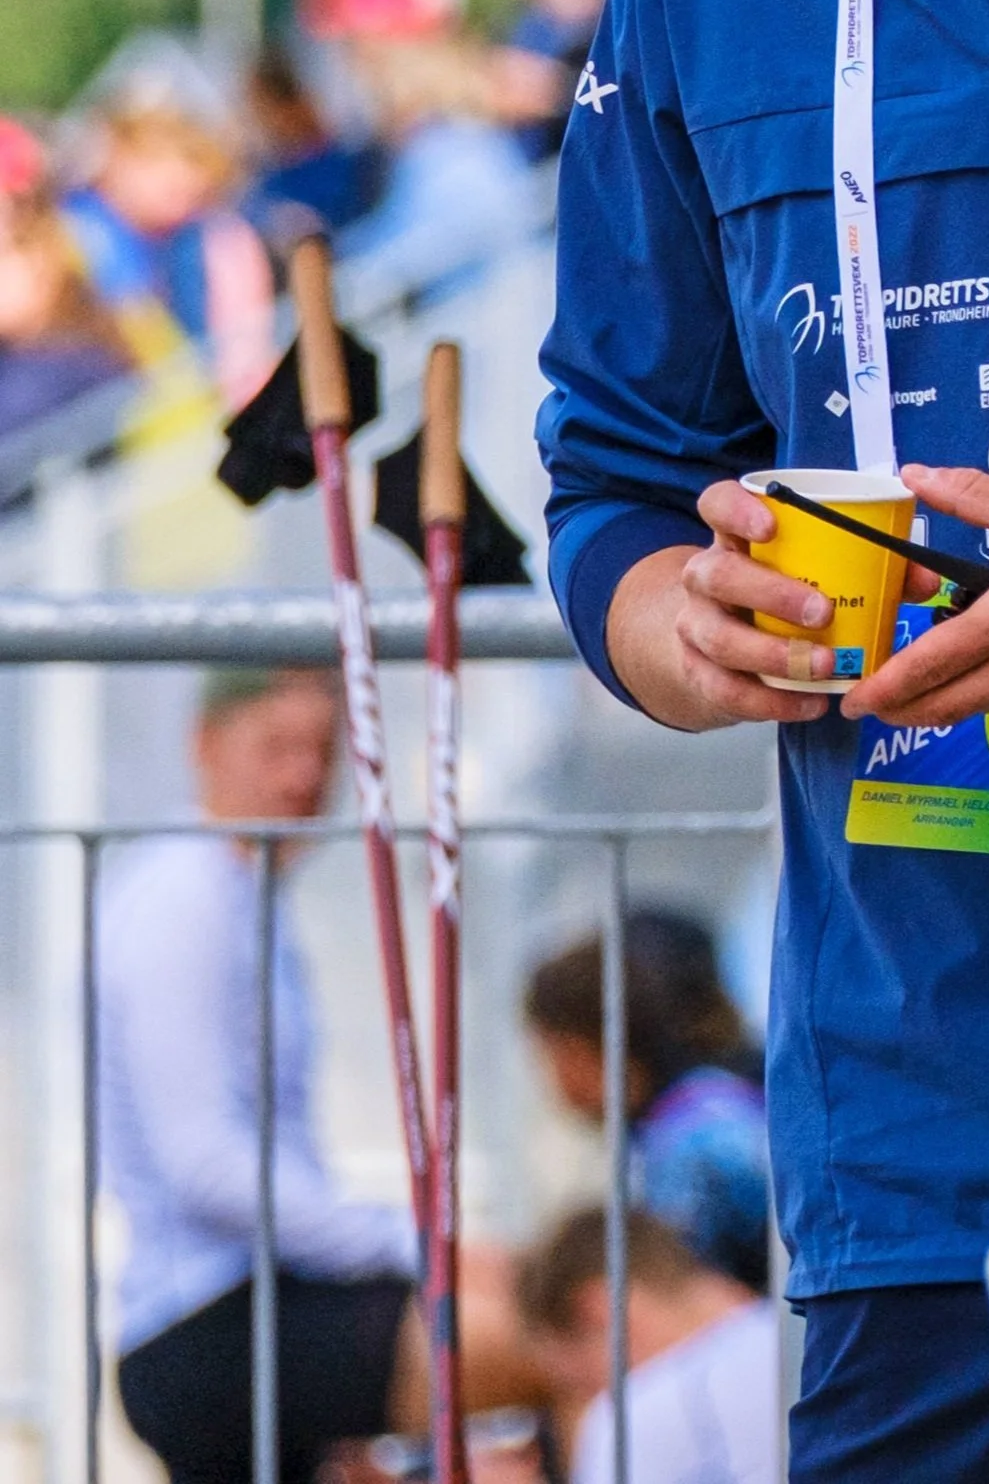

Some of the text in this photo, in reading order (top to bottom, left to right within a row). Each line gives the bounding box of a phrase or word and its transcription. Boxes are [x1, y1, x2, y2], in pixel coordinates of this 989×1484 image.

[840, 171, 868, 204] ANEO
[848, 225, 868, 365] TOPPIDRETTSVEKA 2022
[891, 386, 937, 409] torget
[861, 790, 903, 805] DANIEL
